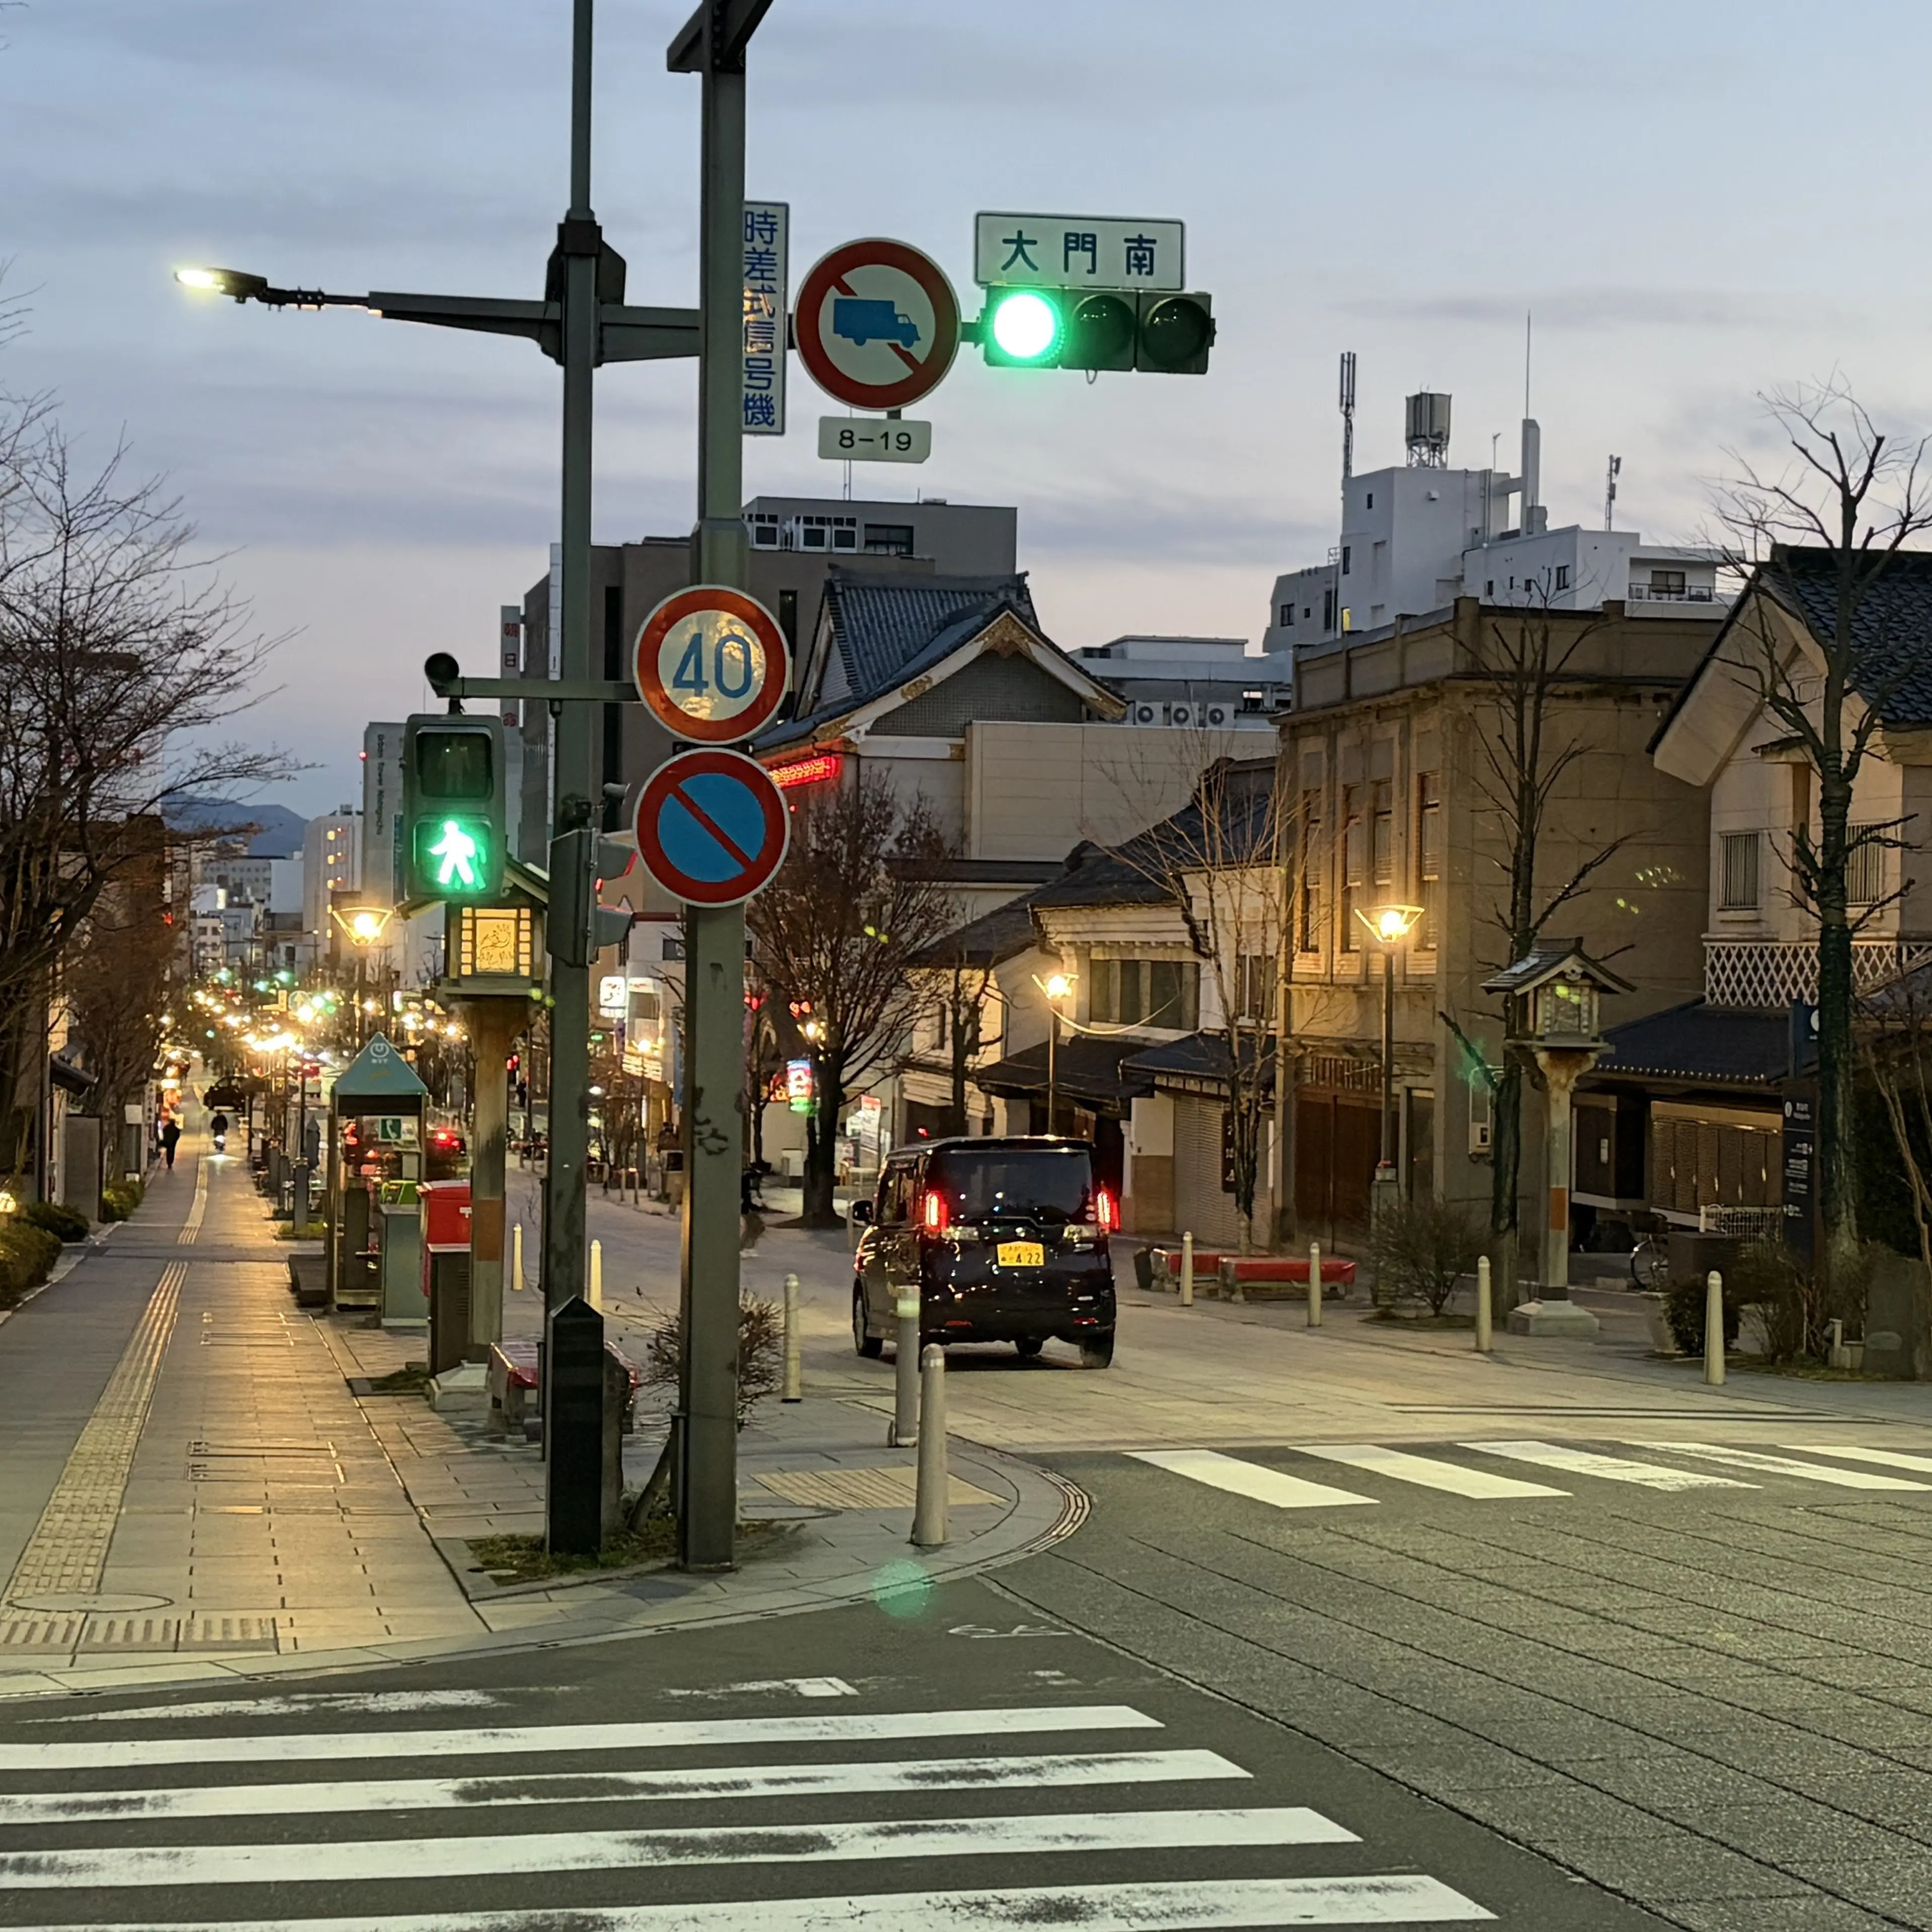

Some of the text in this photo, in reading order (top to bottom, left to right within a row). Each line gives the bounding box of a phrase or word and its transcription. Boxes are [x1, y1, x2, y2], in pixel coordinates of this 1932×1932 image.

[1001, 229, 1157, 277] 大門南
[839, 429, 912, 451] 8-19
[673, 632, 752, 699] 40
